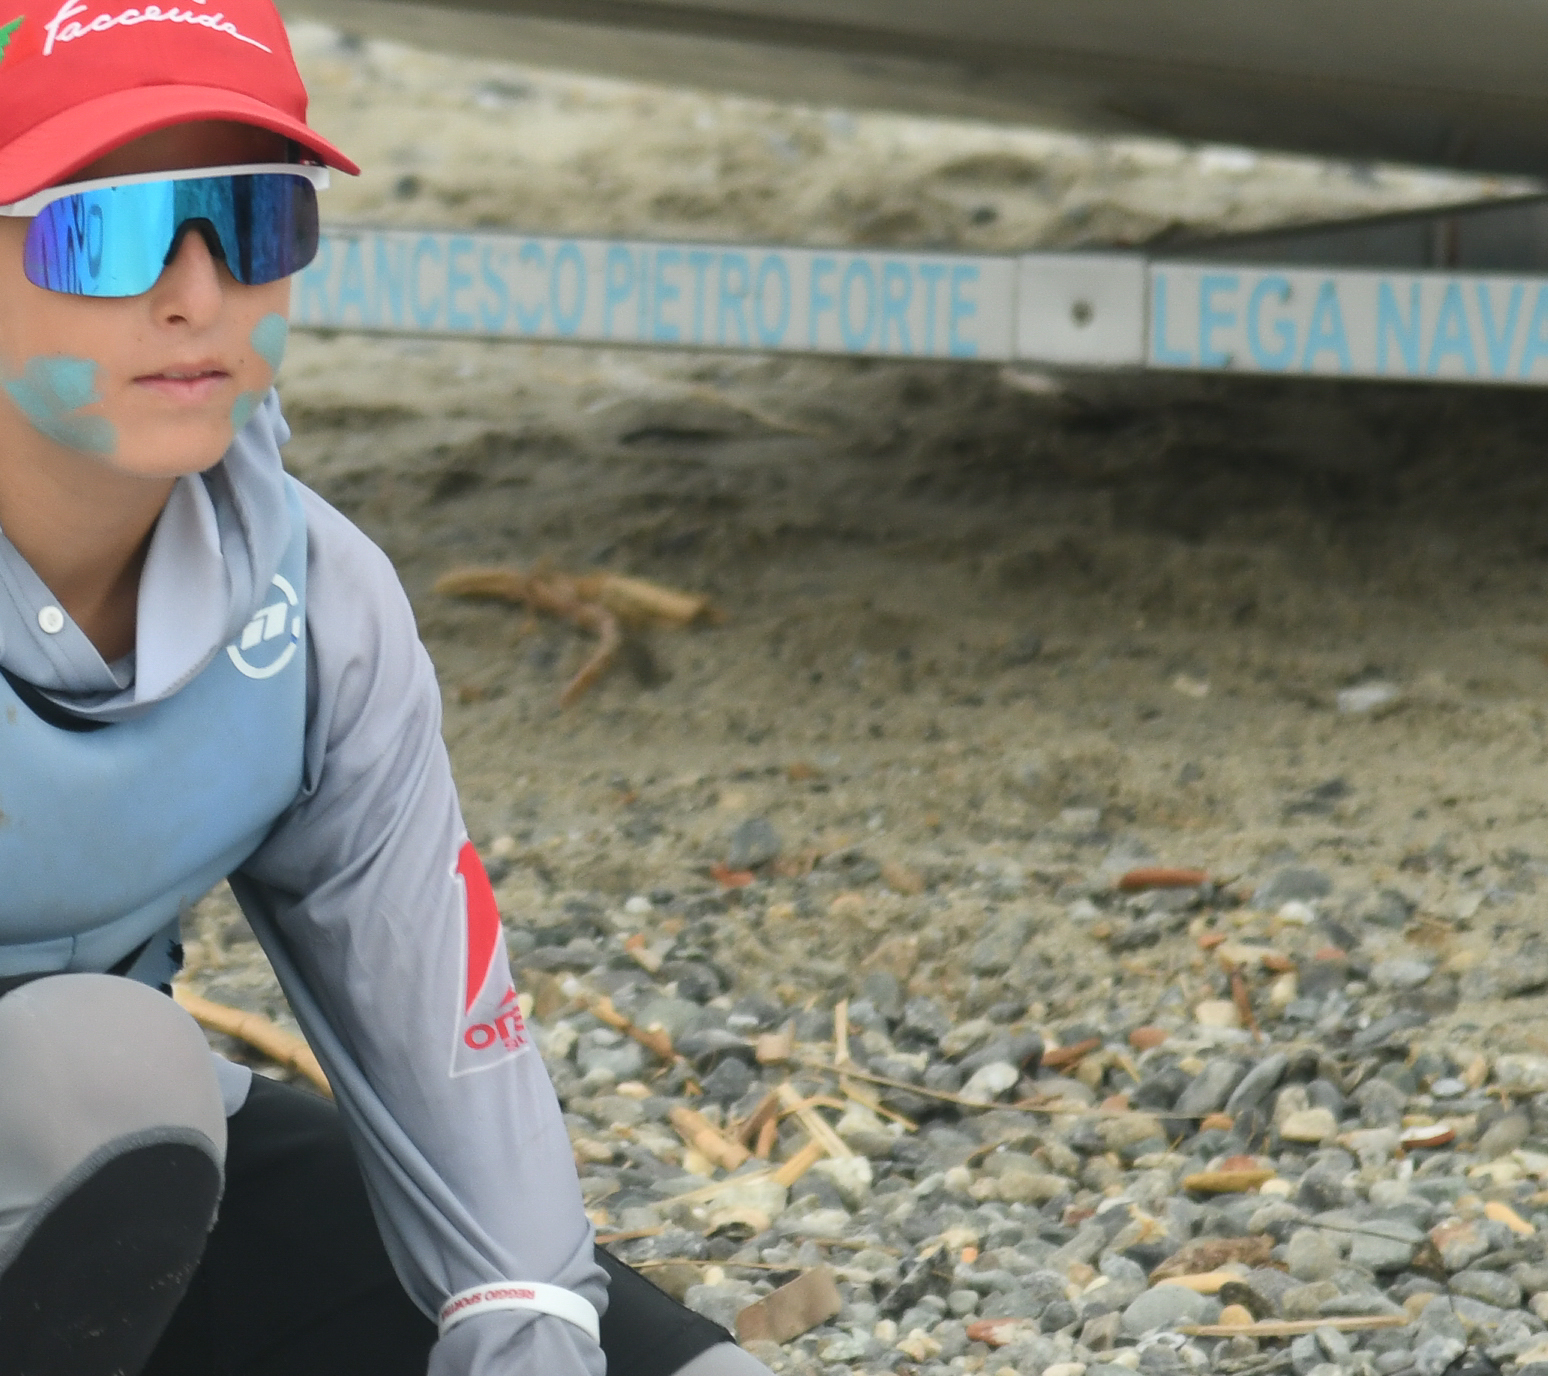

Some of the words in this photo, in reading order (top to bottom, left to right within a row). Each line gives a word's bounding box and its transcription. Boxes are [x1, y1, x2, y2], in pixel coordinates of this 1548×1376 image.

[300, 233, 588, 339] RANCESCO
[603, 244, 793, 348] PIETRO
[807, 257, 982, 358] FORTE
[1153, 272, 1354, 370] LEGA
